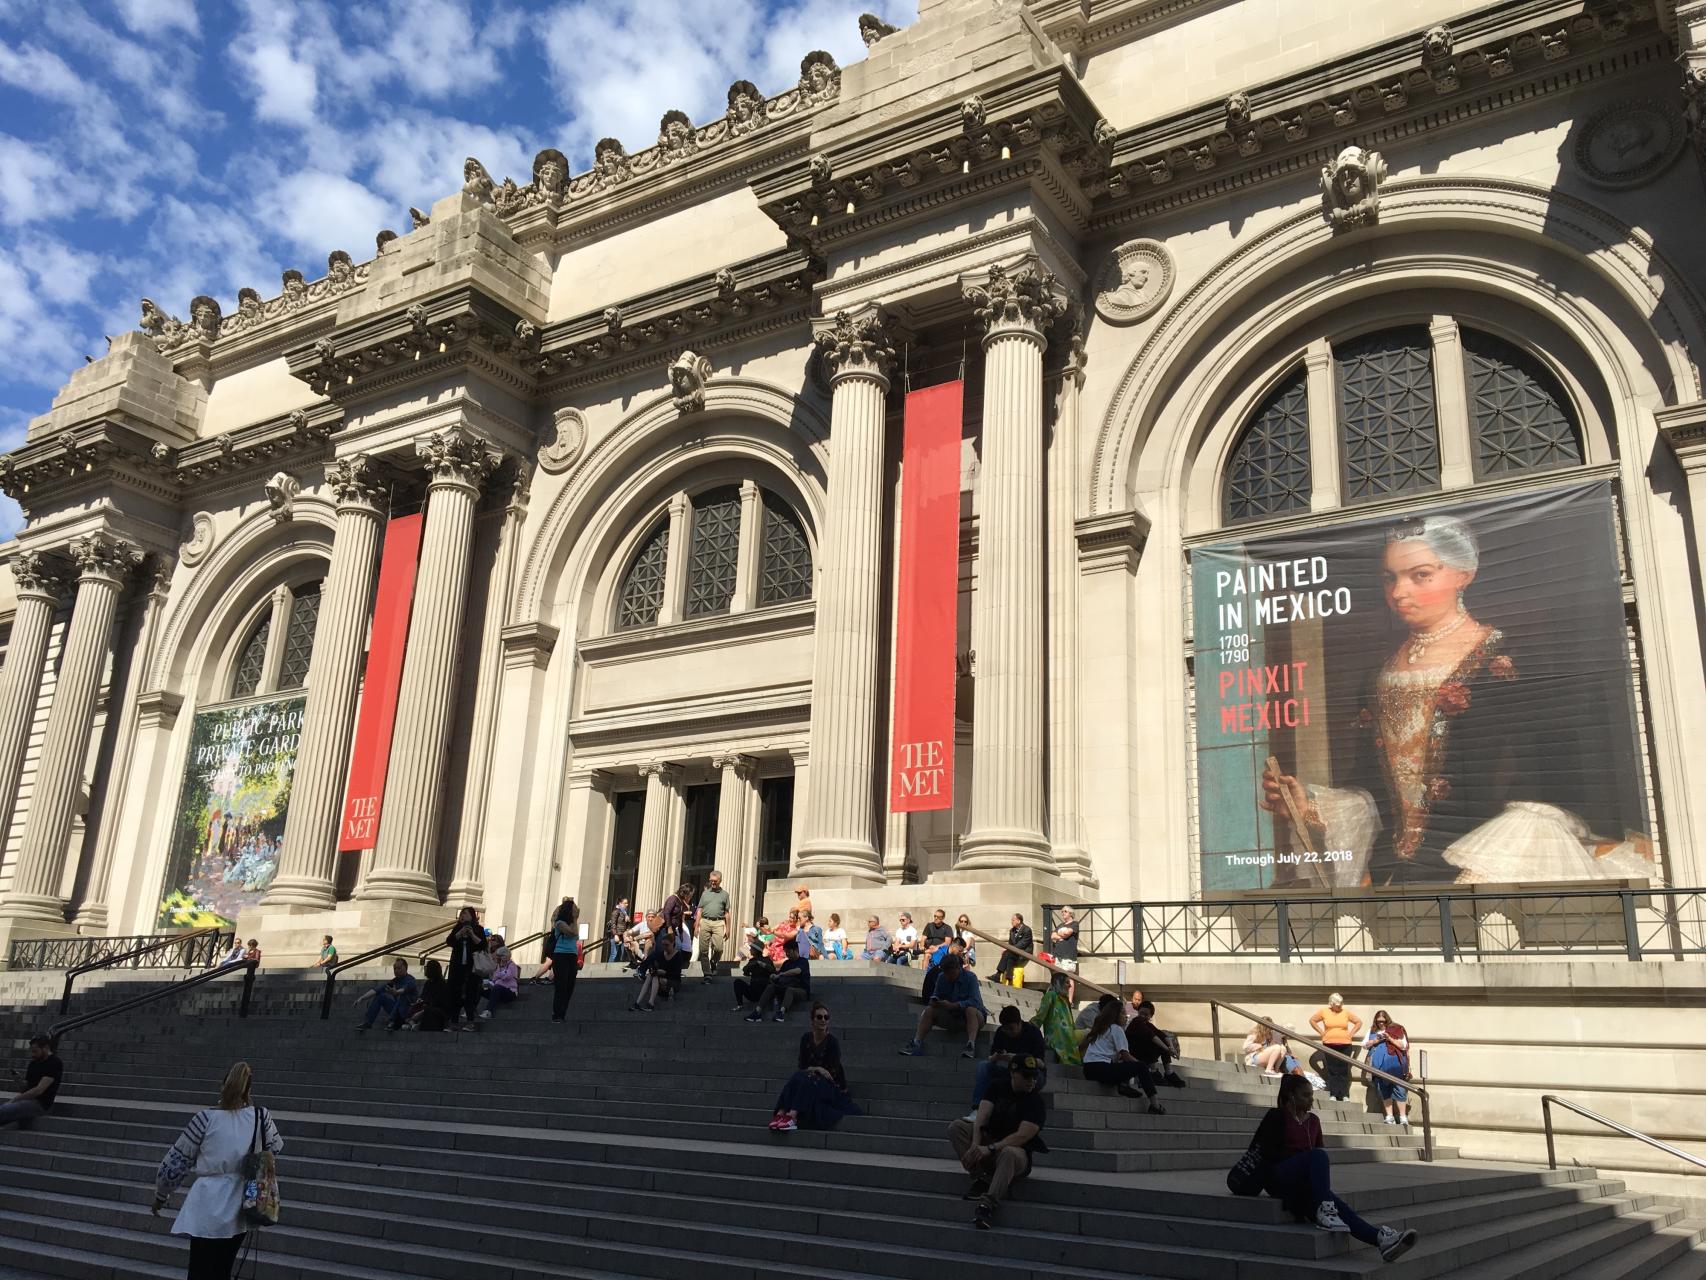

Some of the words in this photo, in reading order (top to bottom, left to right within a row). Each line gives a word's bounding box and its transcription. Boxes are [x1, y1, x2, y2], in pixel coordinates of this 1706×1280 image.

[1216, 556, 1328, 598] PAINTED
[1219, 602, 1243, 631] IN
[1255, 587, 1352, 626] MEXICO
[1219, 634, 1256, 650] 1700-
[1220, 649, 1250, 665] 1790
[1219, 661, 1307, 699] PINXIT
[1220, 698, 1310, 734] MEXICI
[212, 717, 264, 741] PUBLIC
[197, 740, 255, 765] PRIVATE
[900, 740, 944, 769] THE
[239, 764, 252, 777] TO
[899, 768, 945, 798] MET
[351, 796, 377, 818] THE
[345, 818, 375, 840] MET
[1225, 853, 1274, 867] Through
[1277, 852, 1301, 865] July
[1303, 851, 1322, 863] 22,
[1323, 850, 1353, 862] 2018
